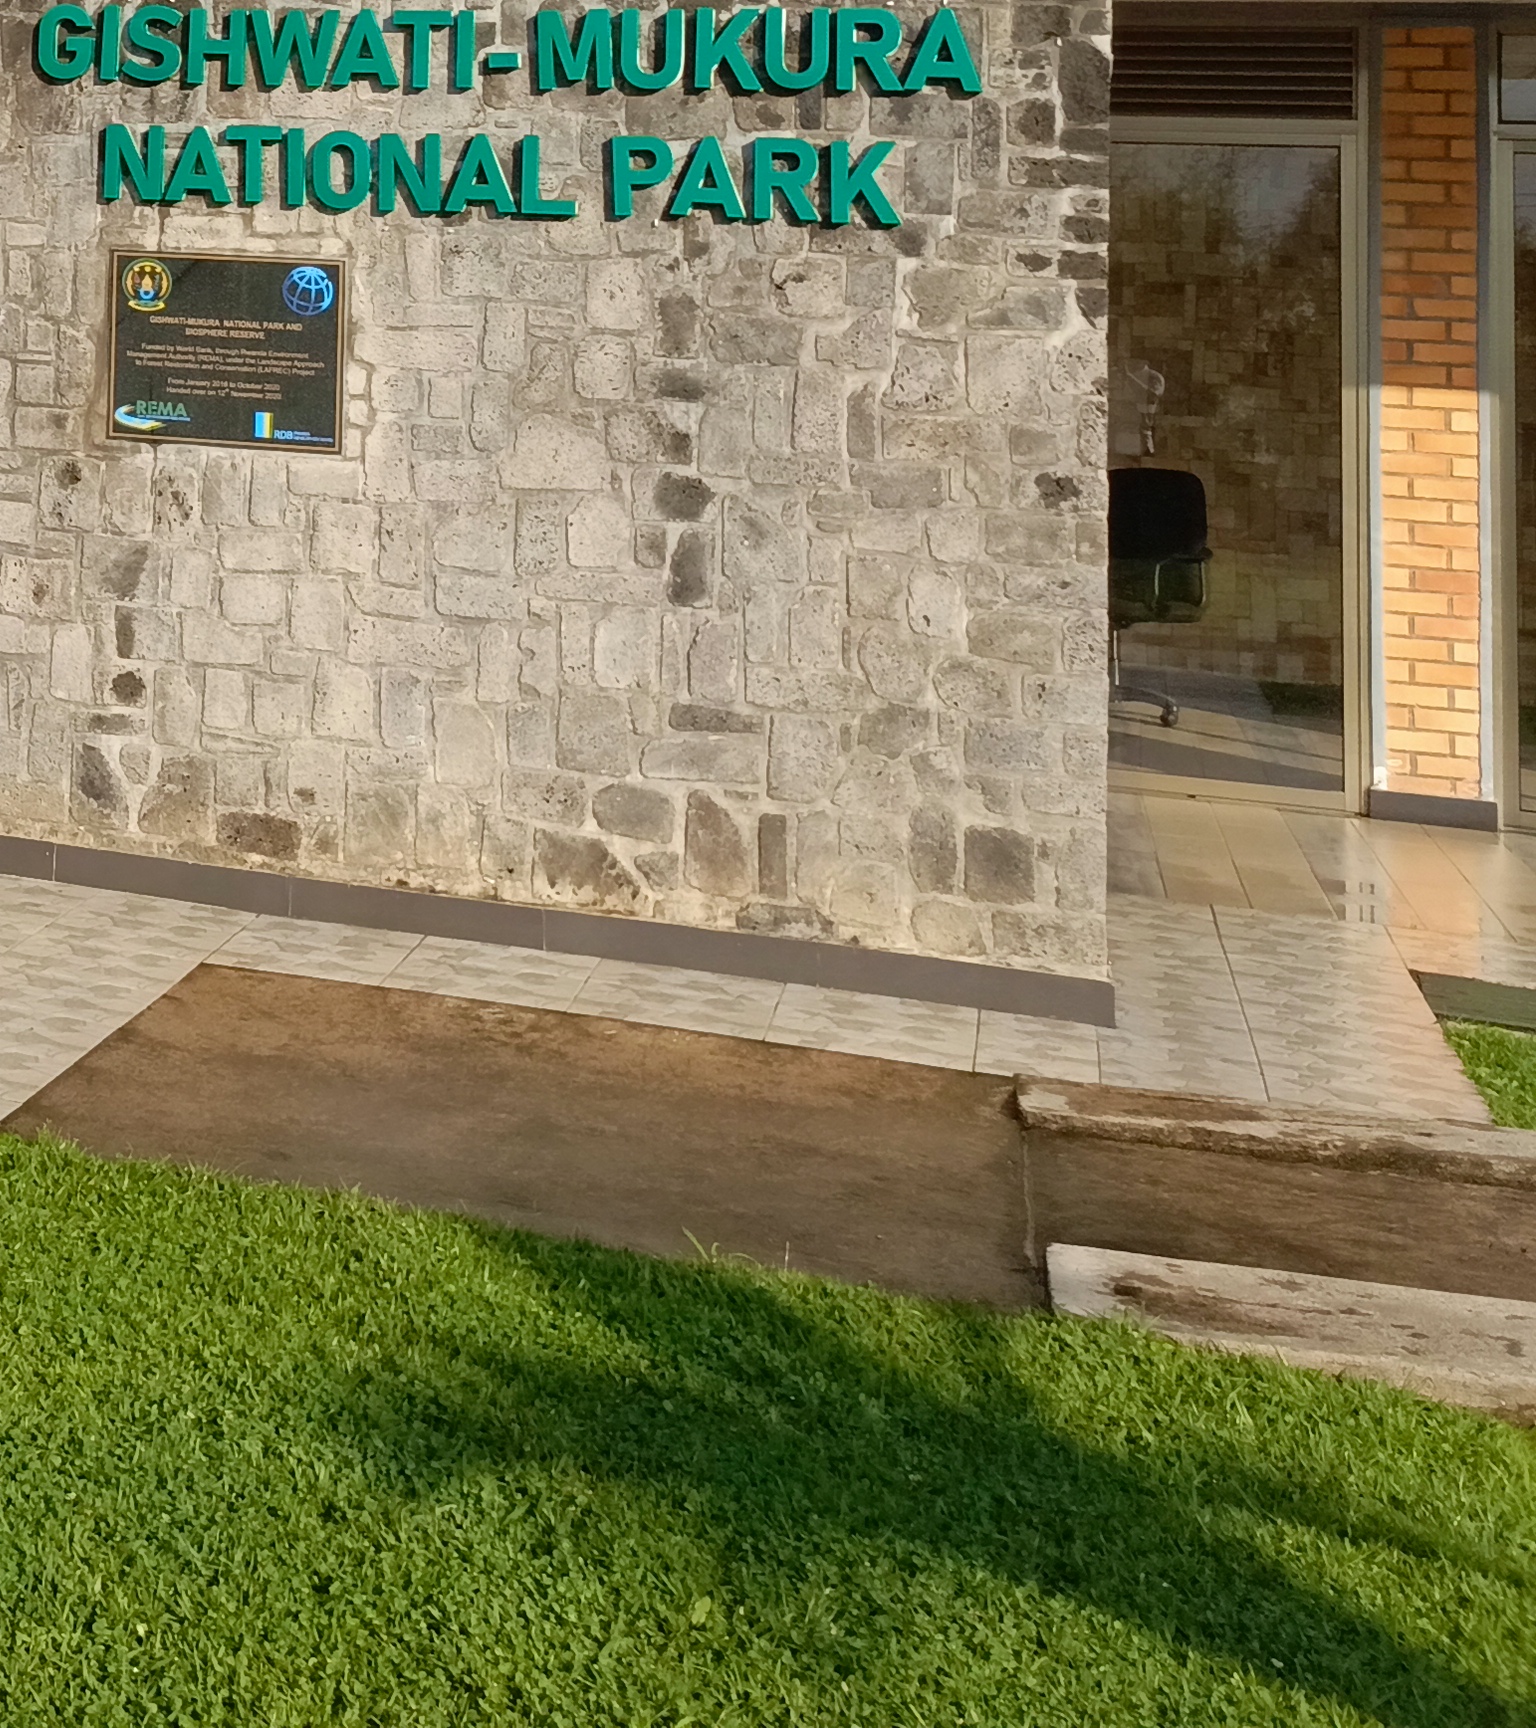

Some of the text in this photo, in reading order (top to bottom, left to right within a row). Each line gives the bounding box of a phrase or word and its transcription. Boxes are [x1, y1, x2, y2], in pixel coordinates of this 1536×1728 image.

[36, 3, 984, 94] GISHWATI-MUKURA
[101, 123, 902, 229] NATIONAL PARK
[223, 319, 262, 329] NATIONAL
[263, 321, 285, 331] PARK
[286, 323, 303, 331] AND
[185, 327, 265, 340] BIOSPHERE RESERVE
[136, 400, 188, 417] REMA
[273, 429, 293, 440] RDB
